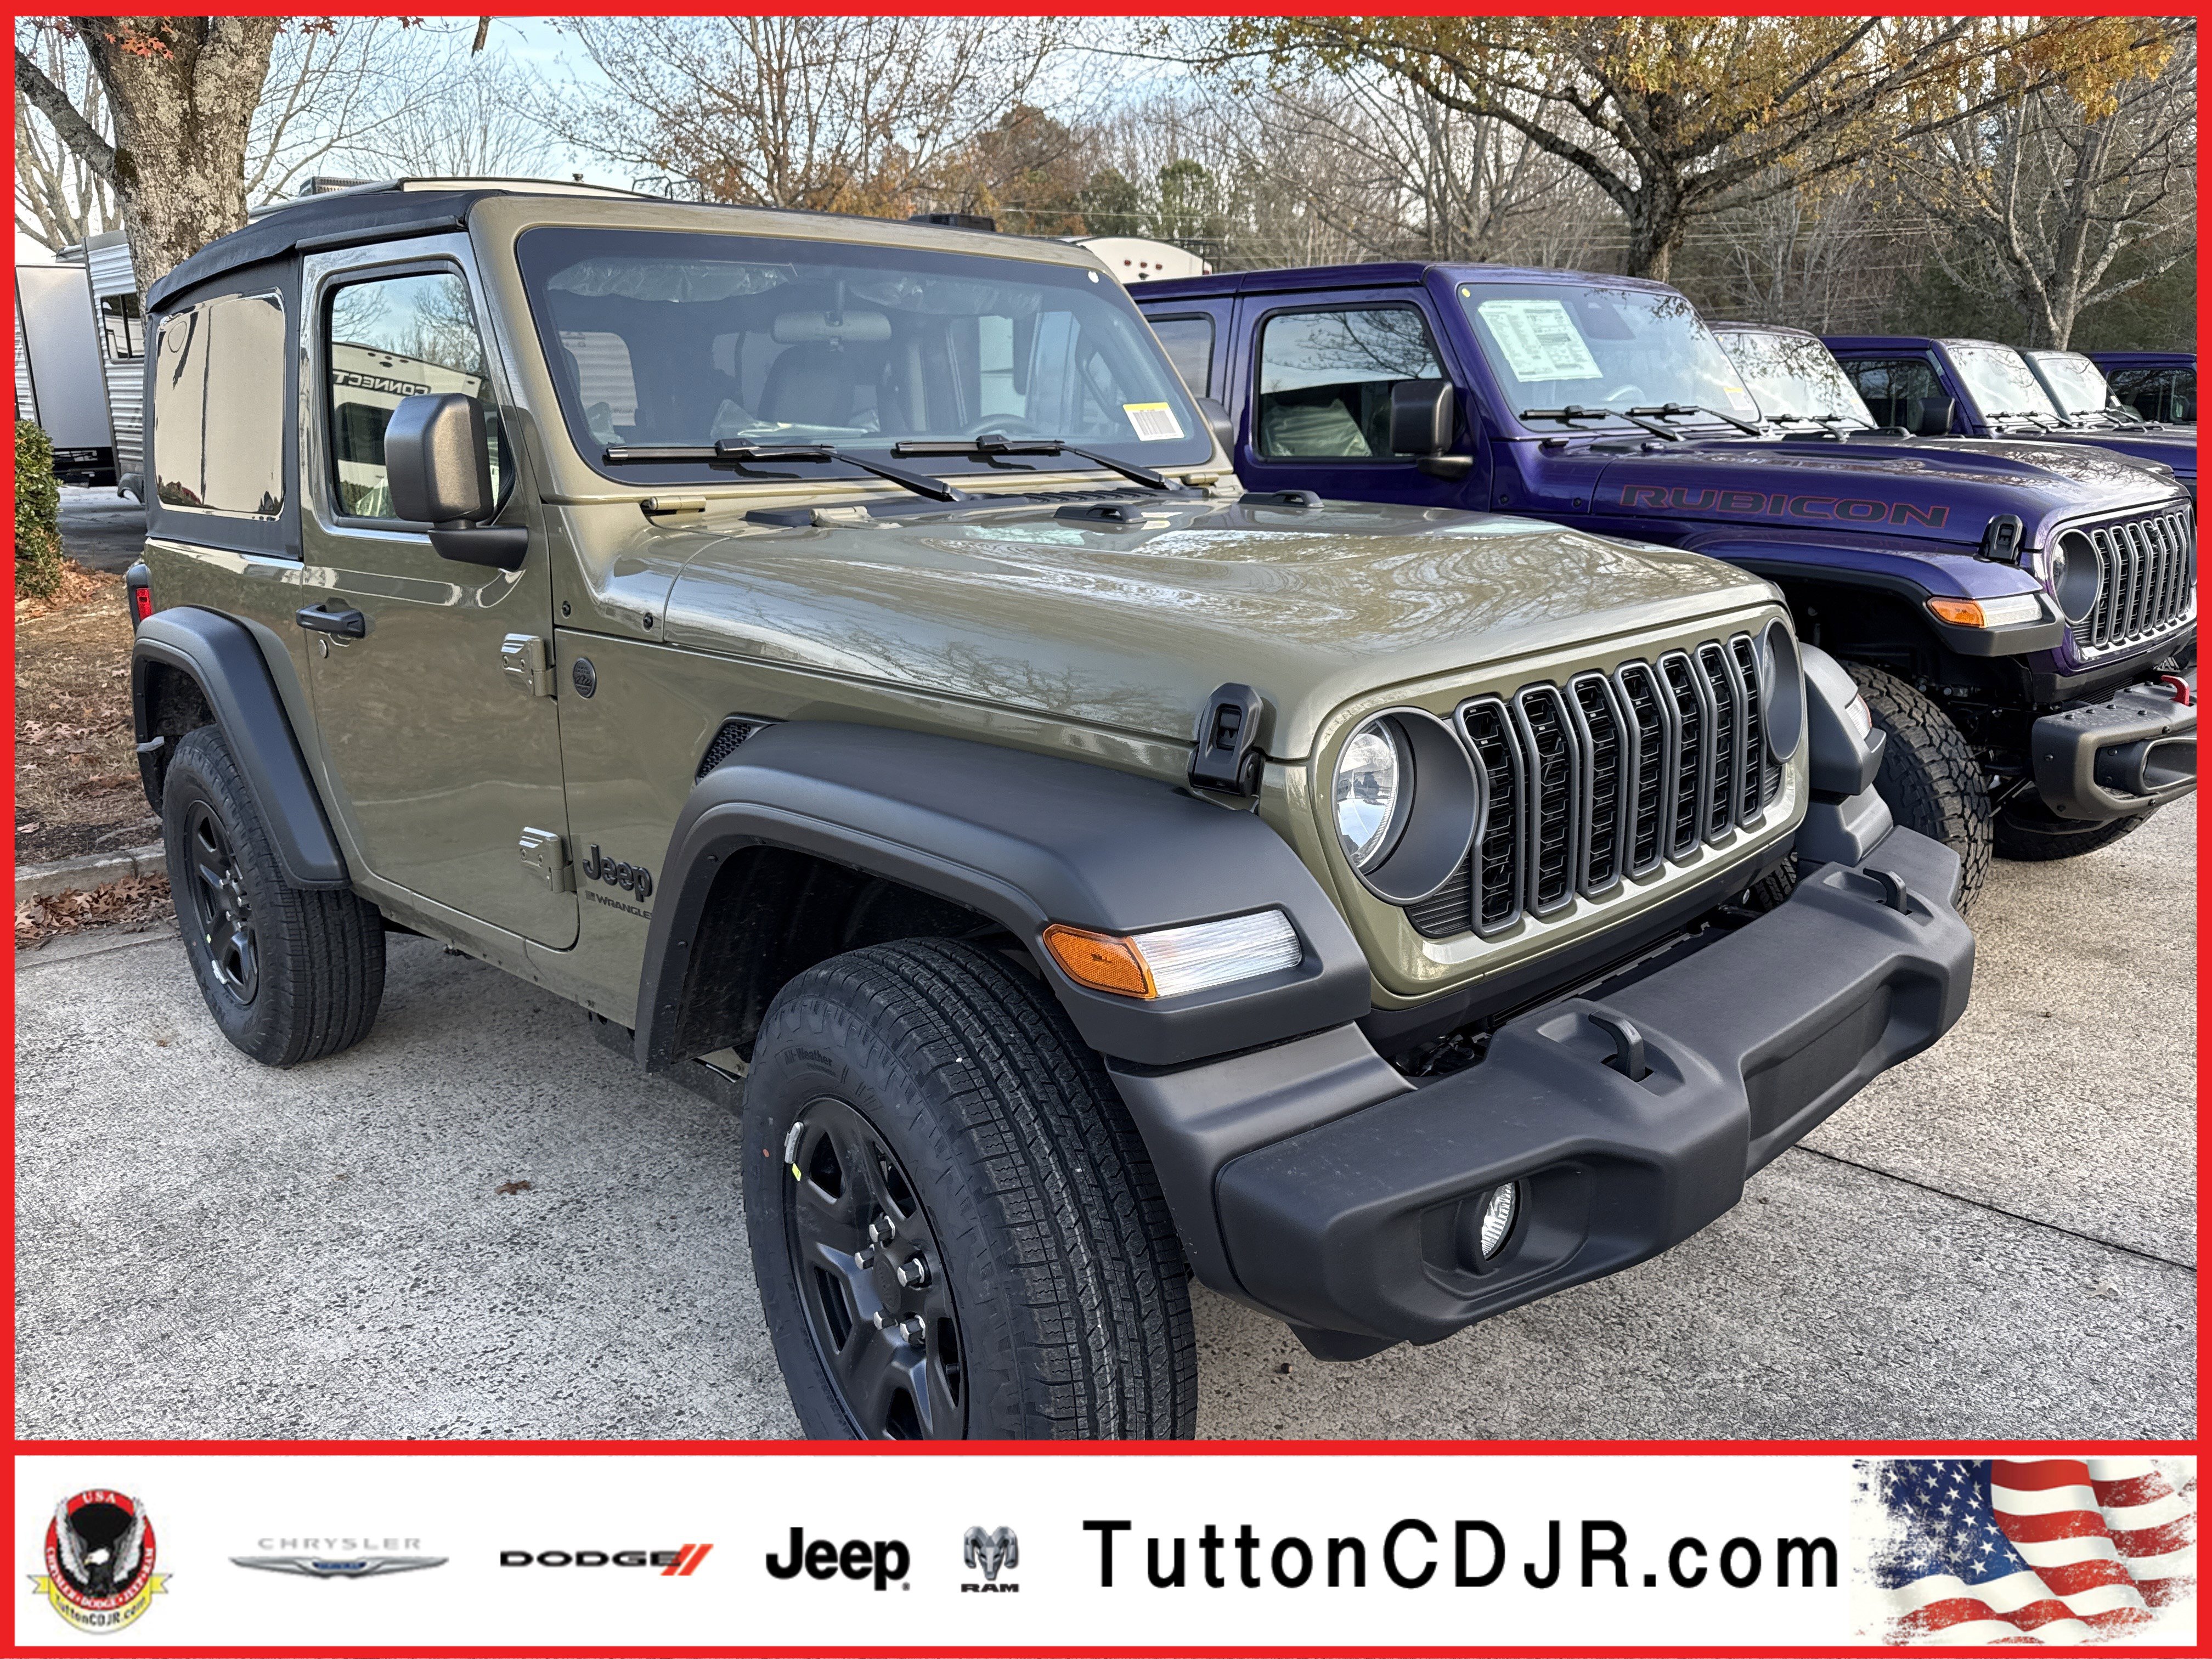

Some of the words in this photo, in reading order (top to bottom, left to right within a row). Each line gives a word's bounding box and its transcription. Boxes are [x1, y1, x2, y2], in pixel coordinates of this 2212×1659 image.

[1620, 485, 1950, 528] RUBICON
[582, 843, 652, 902] Jeep
[596, 893, 652, 920] WRANGLE
